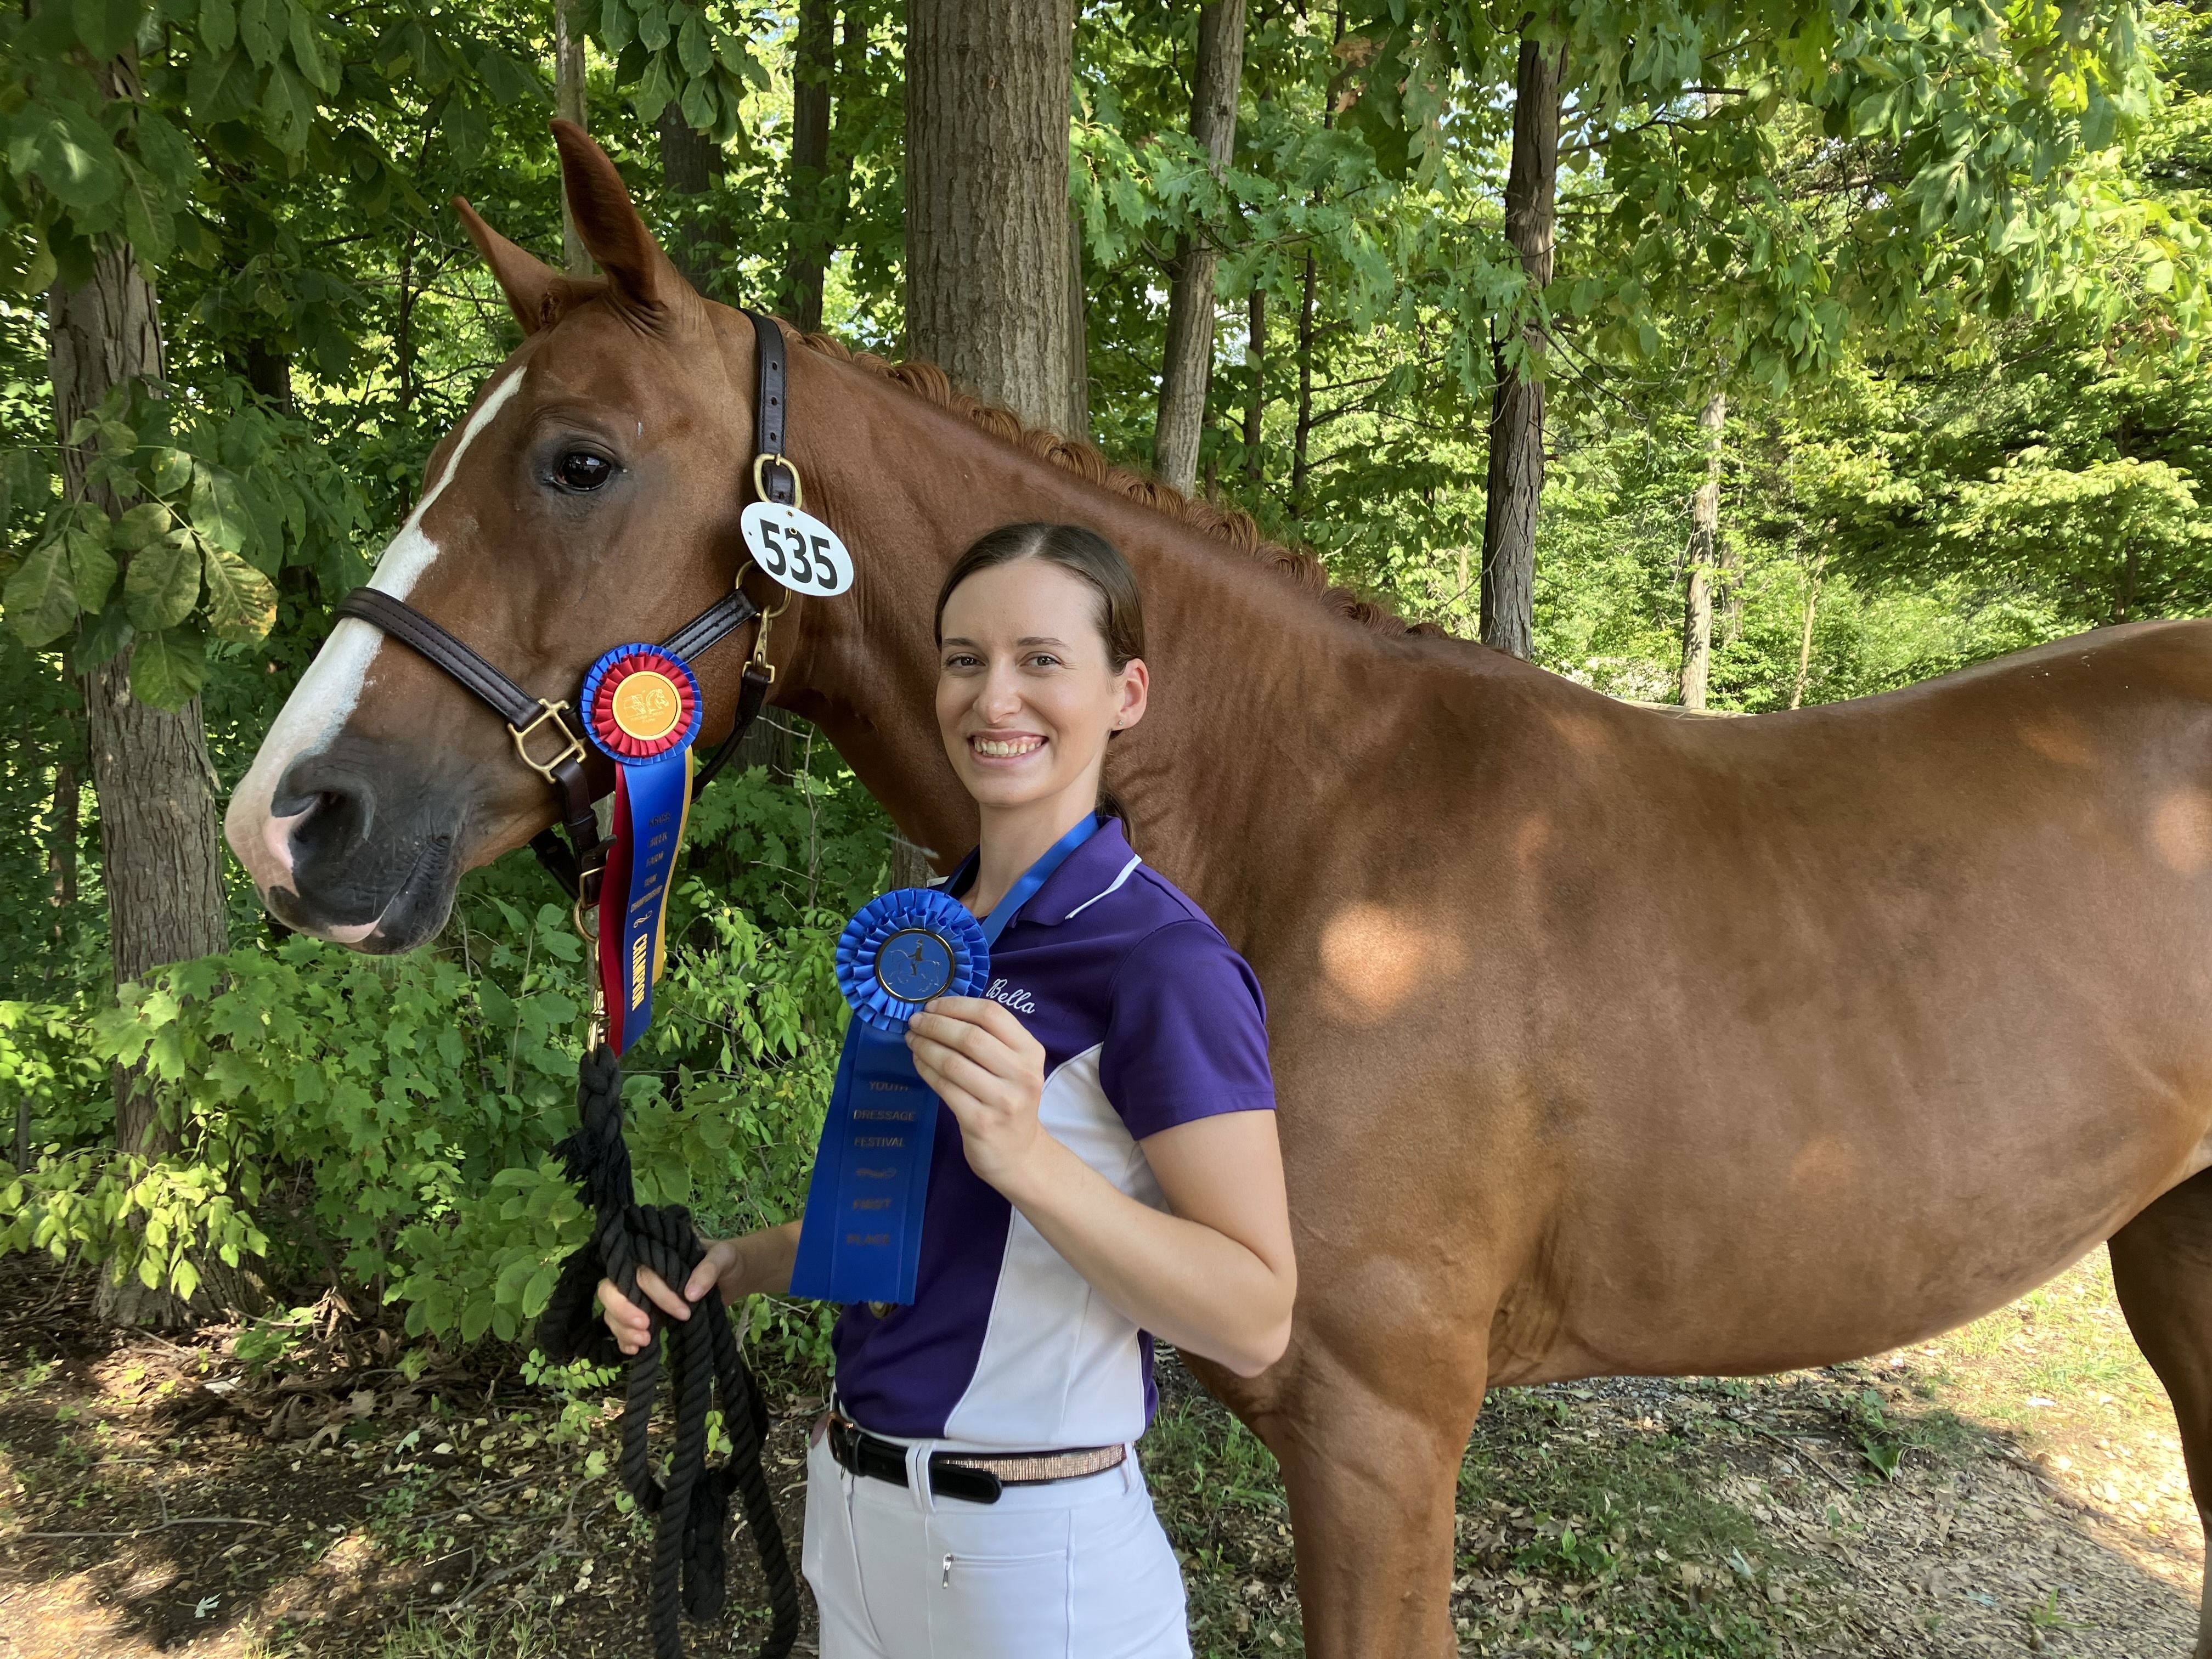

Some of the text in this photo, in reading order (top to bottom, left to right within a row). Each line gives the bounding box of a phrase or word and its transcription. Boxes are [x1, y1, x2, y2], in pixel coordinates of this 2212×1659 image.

[759, 518, 838, 590] 535
[632, 933, 648, 1011] CHAMPION
[986, 978, 1035, 1014] Bella
[853, 1109, 916, 1121] DRESSAGE
[854, 1137, 905, 1148] FESTIVAL
